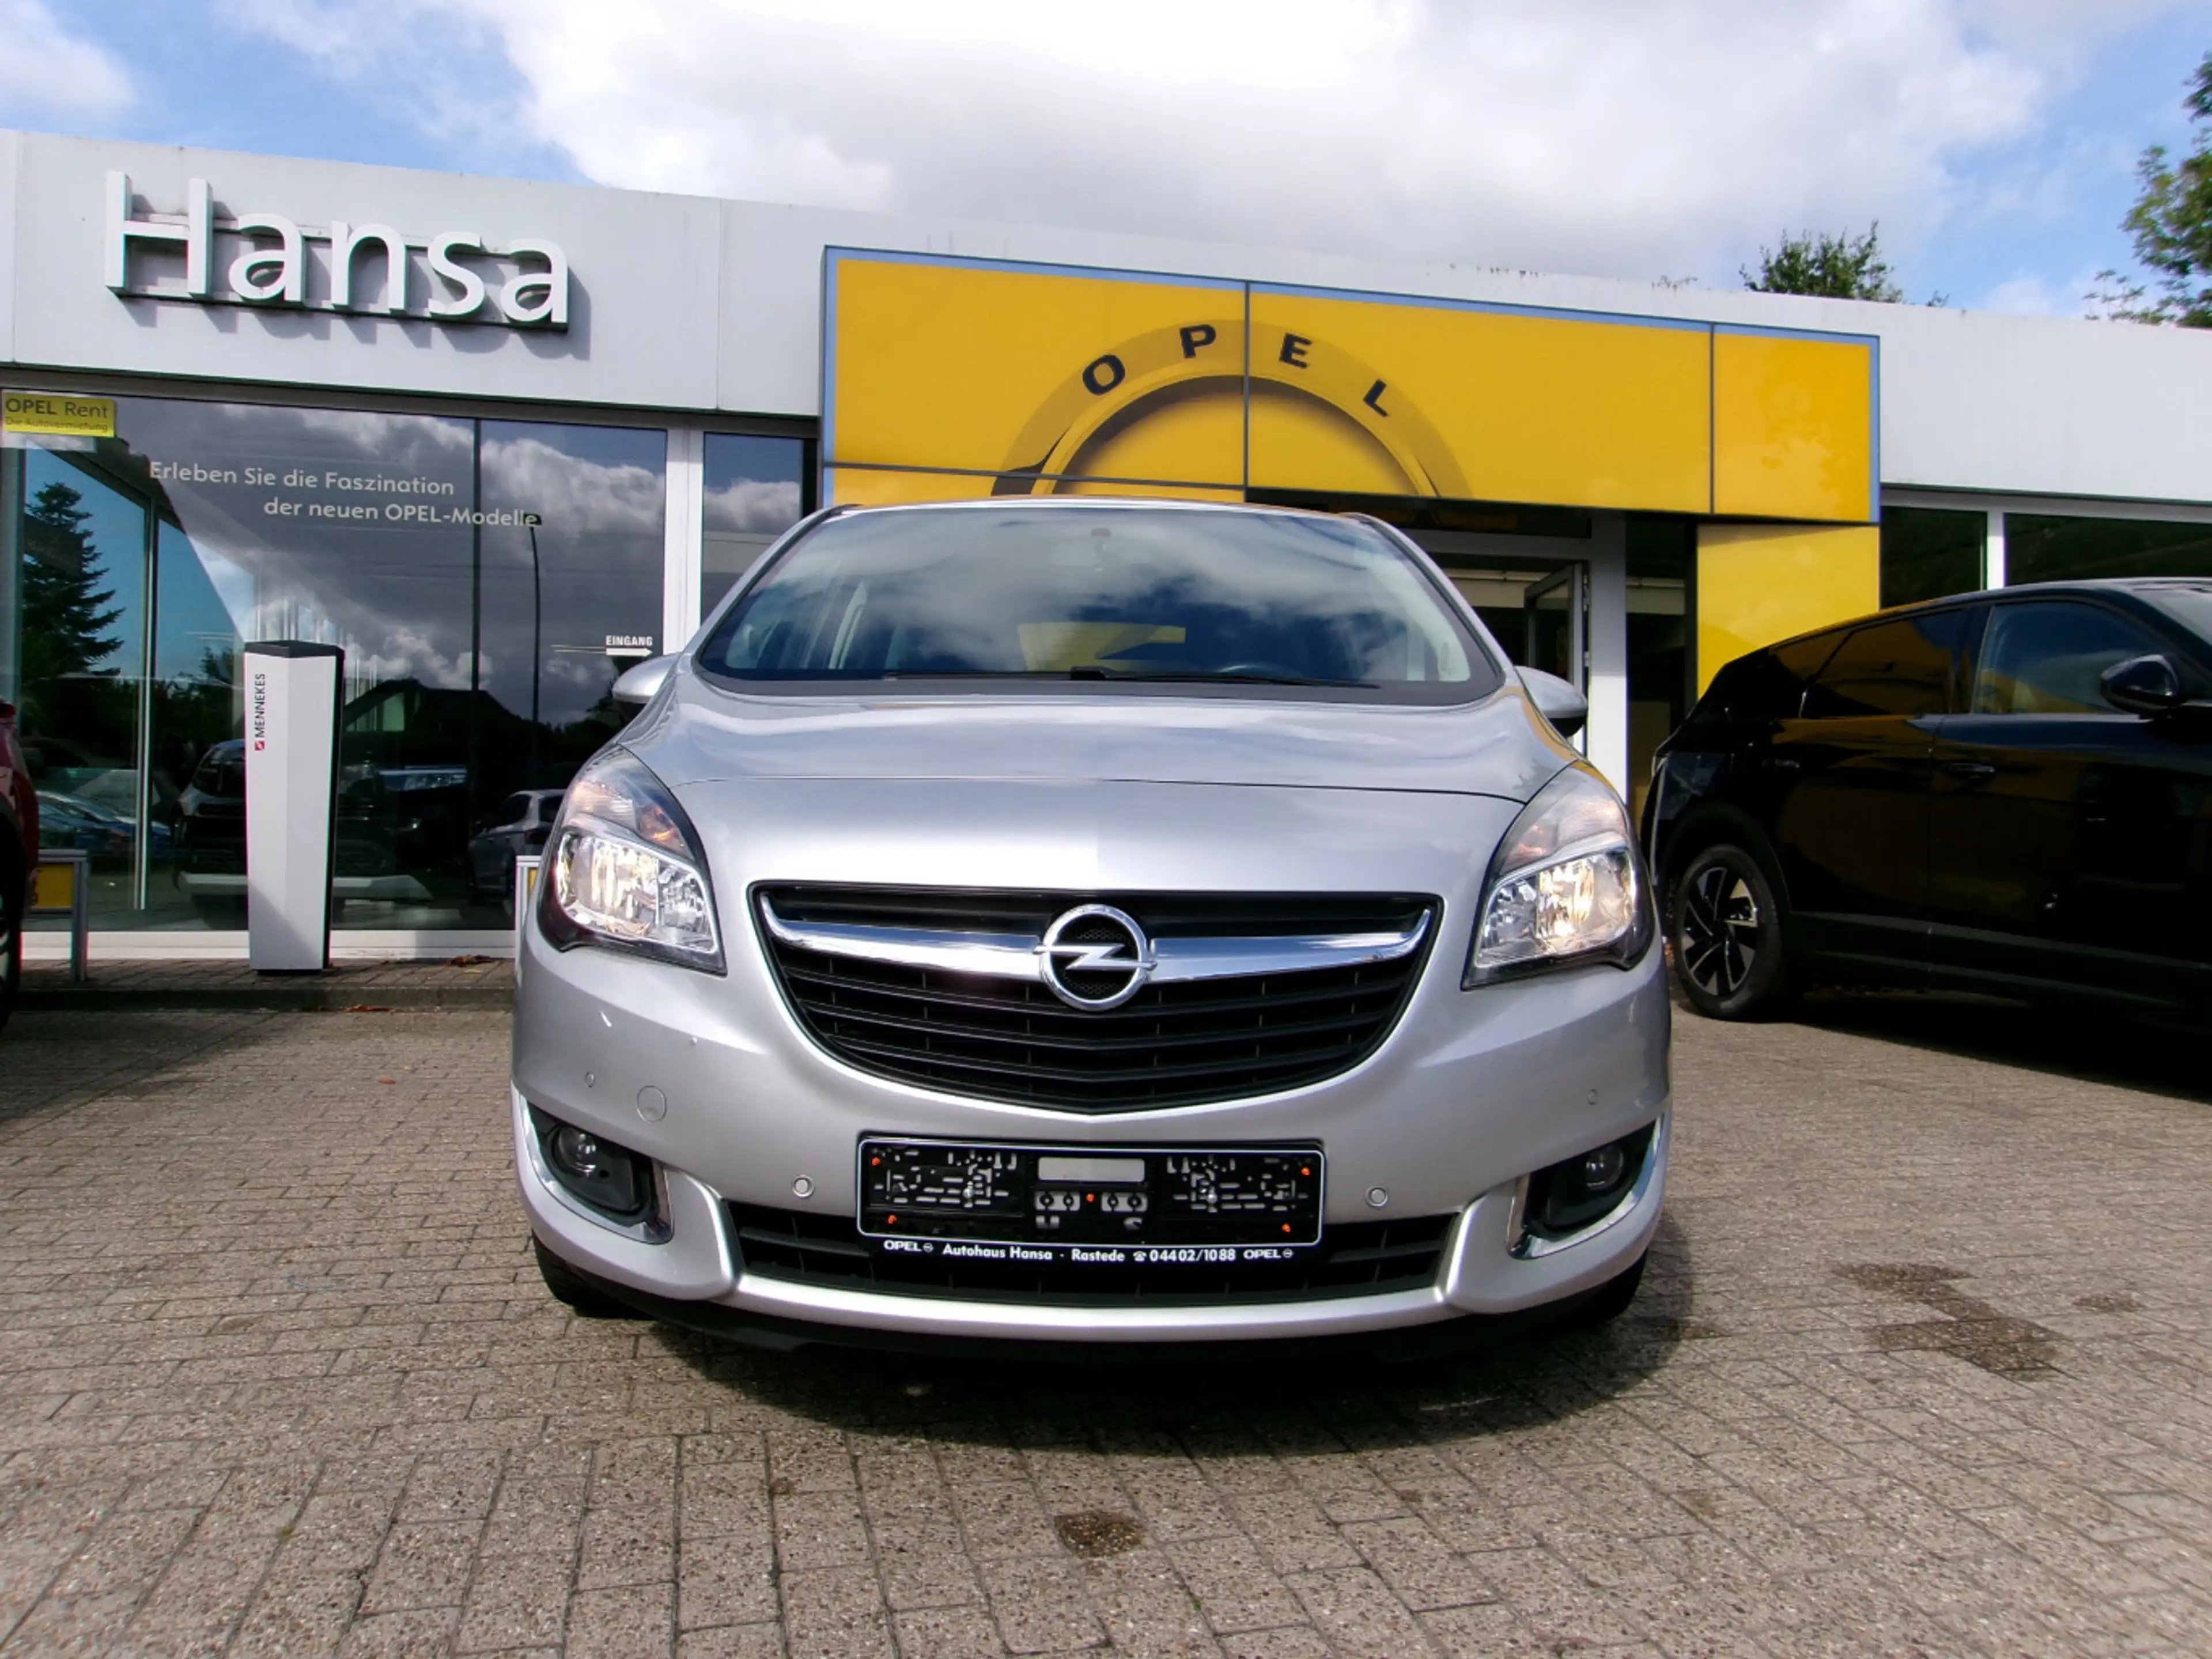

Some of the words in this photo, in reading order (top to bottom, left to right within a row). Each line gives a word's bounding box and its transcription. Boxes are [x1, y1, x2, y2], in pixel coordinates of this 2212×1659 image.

[105, 171, 568, 332] Hansa
[1082, 324, 1390, 417] OPEL
[6, 398, 58, 415] OPEL
[65, 402, 108, 418] Rent
[150, 461, 237, 483] Erleben
[244, 467, 276, 485] Sie
[283, 469, 318, 487] die
[325, 472, 454, 495] Faszination
[263, 497, 302, 516] der
[309, 502, 378, 519] neuen
[385, 503, 538, 527] OPEL-Modelle
[606, 635, 653, 646] EINGANG
[254, 673, 265, 738] MENNEKES
[883, 1240, 921, 1252] OPEL
[942, 1243, 1005, 1259] Autohaus
[1009, 1247, 1053, 1260] Hansa
[1071, 1248, 1125, 1262] Rastede
[1149, 1249, 1236, 1262] 04402/1088
[1243, 1249, 1281, 1259] OPEL
